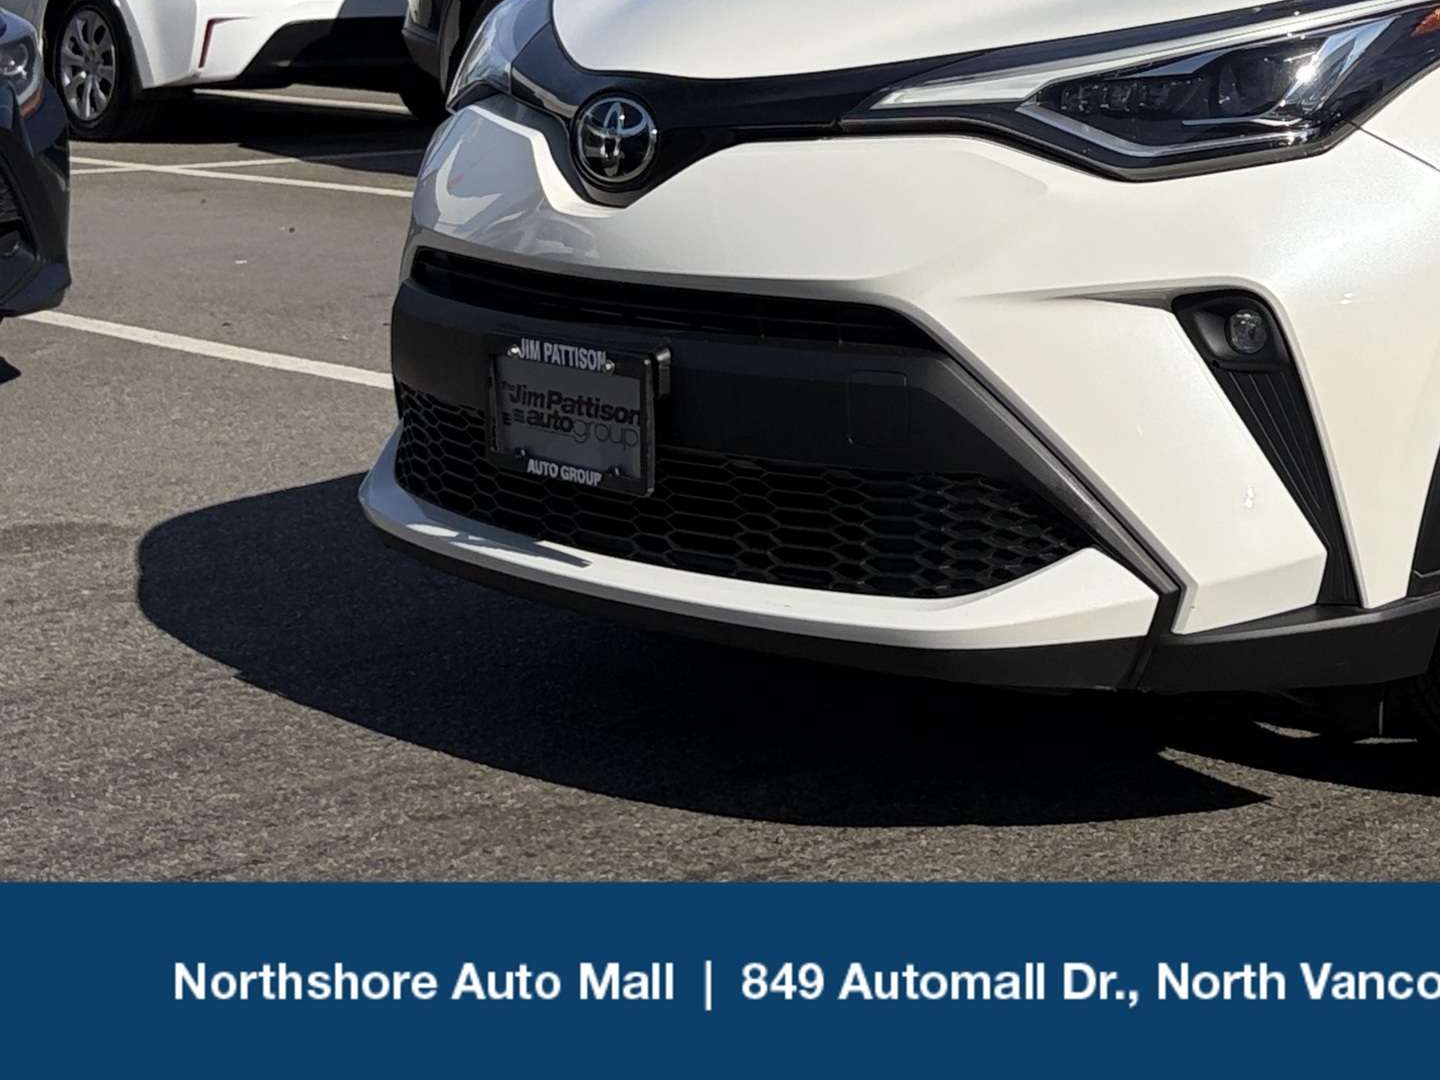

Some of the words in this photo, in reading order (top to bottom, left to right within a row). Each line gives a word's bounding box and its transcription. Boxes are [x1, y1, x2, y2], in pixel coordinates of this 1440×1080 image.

[518, 337, 541, 361] JIM
[543, 341, 608, 370] PATTISON
[526, 458, 558, 479] AUTO
[560, 465, 603, 487] GROUP
